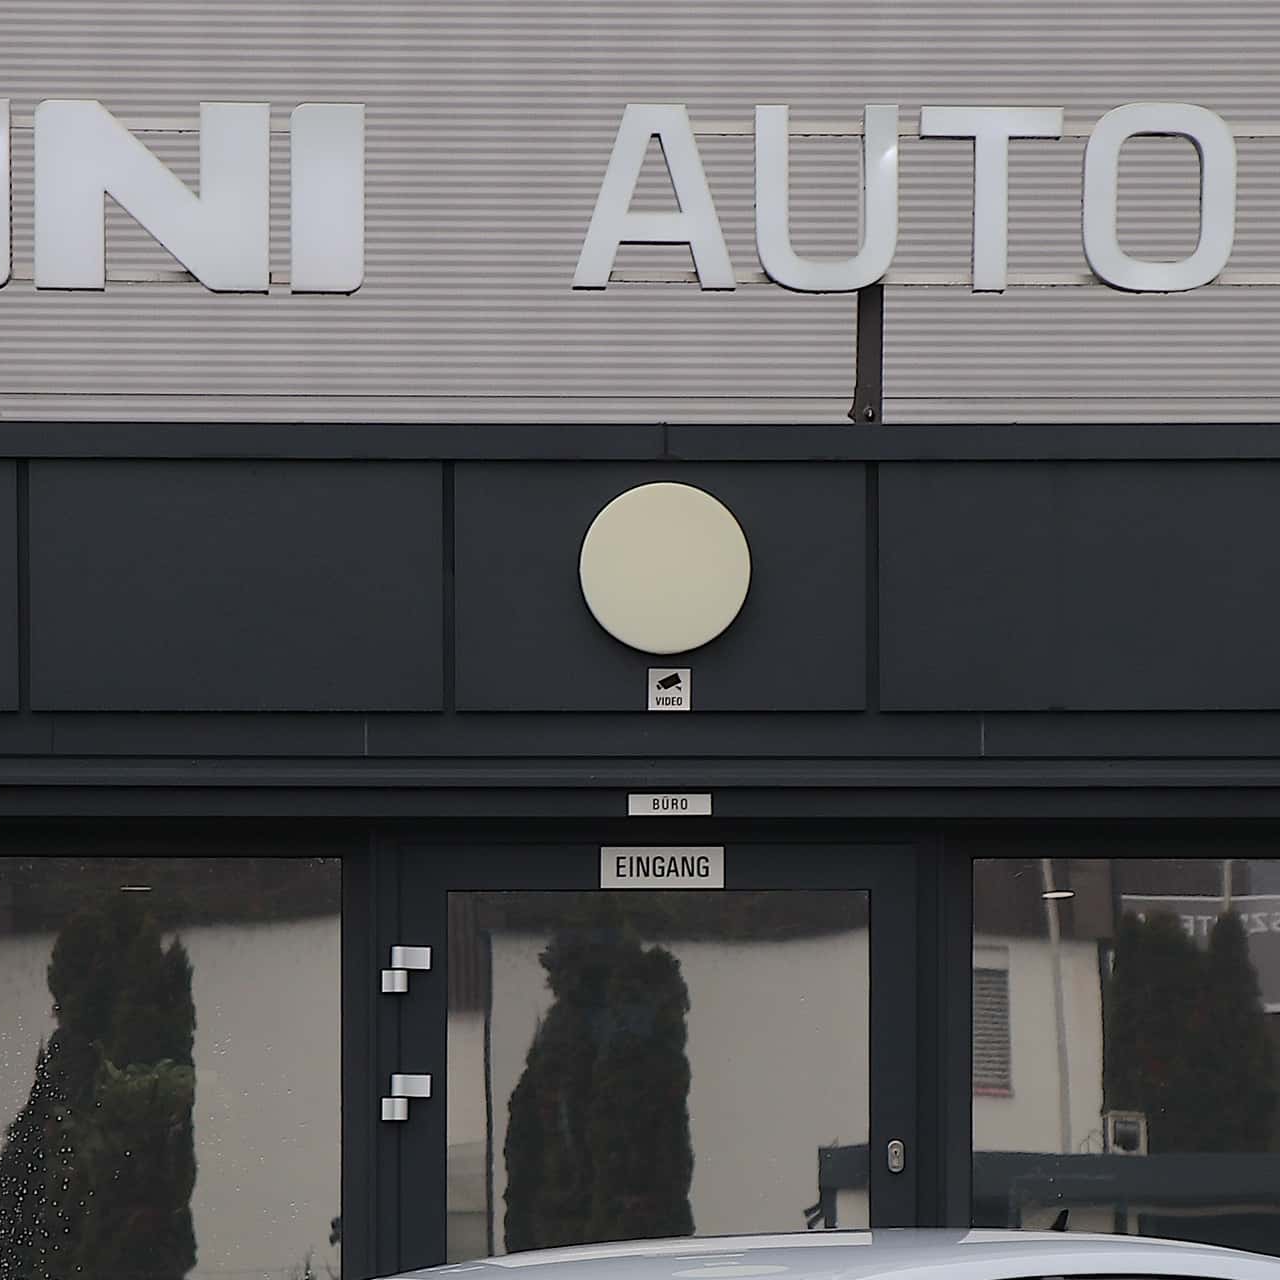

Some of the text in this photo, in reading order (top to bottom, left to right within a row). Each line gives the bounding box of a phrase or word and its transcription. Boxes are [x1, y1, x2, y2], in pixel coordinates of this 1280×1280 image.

[572, 100, 1239, 293] AUTO
[655, 696, 683, 706] VIDEO
[652, 796, 688, 810] BÜRO
[615, 855, 710, 878] EINGANG
